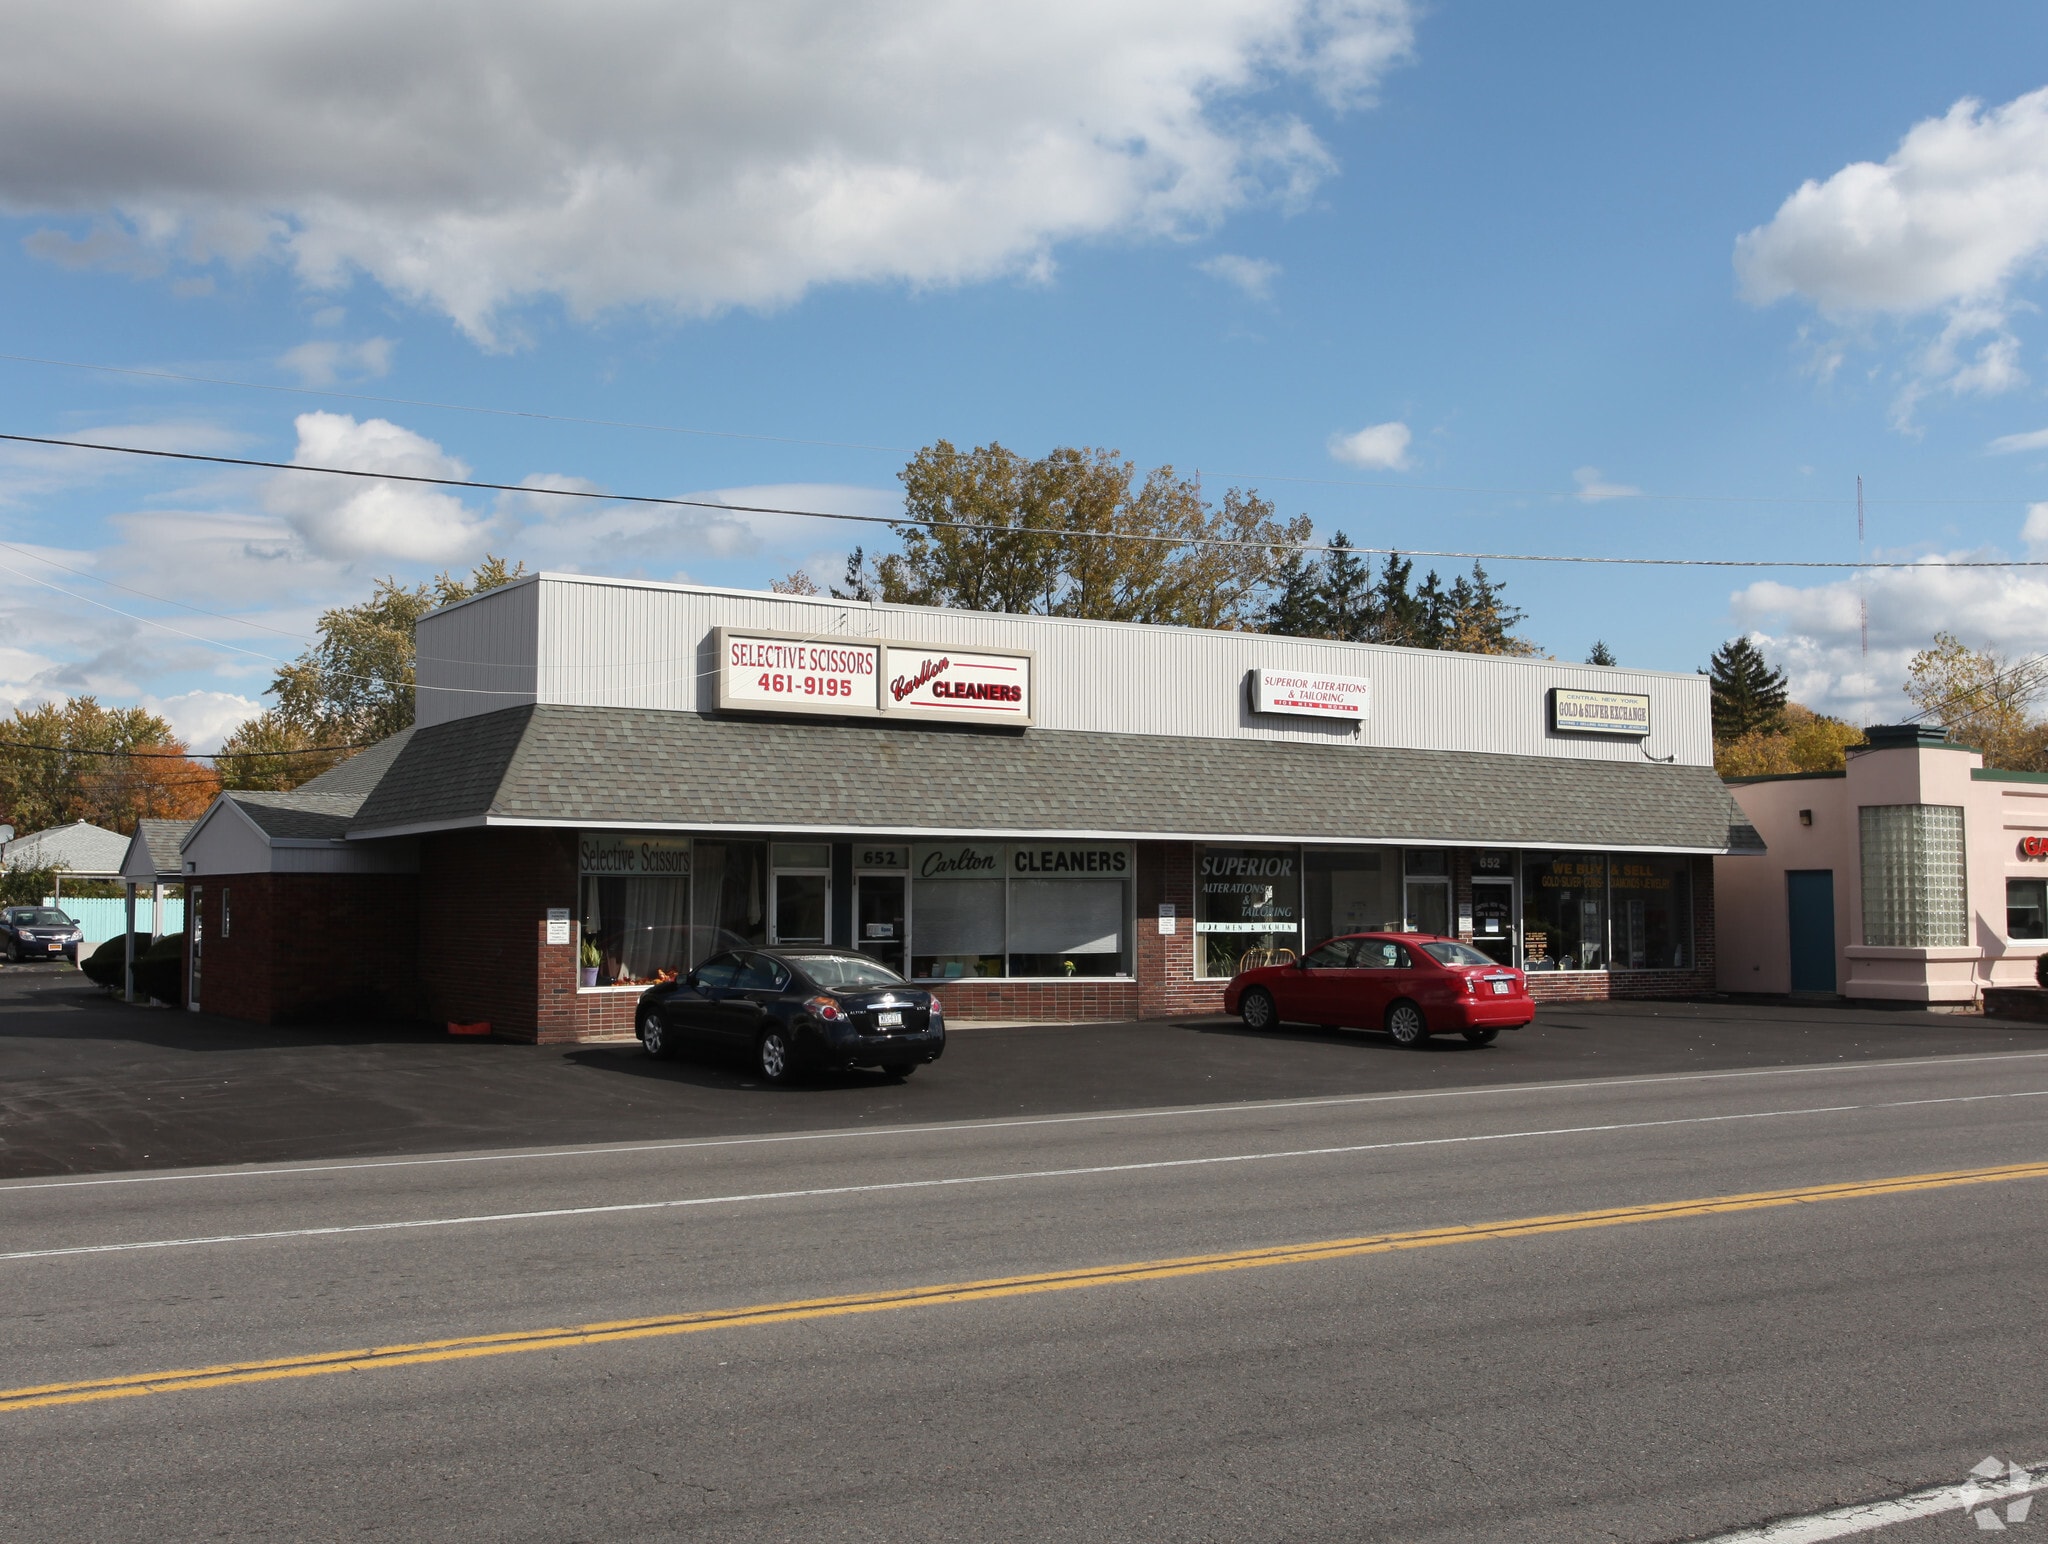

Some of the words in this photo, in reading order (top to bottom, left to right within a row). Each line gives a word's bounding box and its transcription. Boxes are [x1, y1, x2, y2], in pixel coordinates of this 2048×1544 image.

[731, 642, 806, 670] SELECTIVE
[810, 647, 873, 675] SCISSORS
[758, 673, 852, 697] 461-9195
[890, 655, 950, 702] Carlton
[1264, 676, 1308, 689] SUPERIOR
[1311, 680, 1367, 694] ALTERATIONS
[932, 680, 1022, 702] CLEANERS
[1287, 690, 1296, 699] &
[1299, 690, 1344, 702] TAILORING
[1566, 694, 1599, 702] CENTRAL
[1559, 701, 1578, 717] GOLD
[1579, 703, 1584, 718] &
[1584, 703, 1609, 720] SILVER
[1609, 705, 1647, 722] EXCHANGE
[581, 840, 635, 871] Selective
[641, 842, 689, 872] Scissors
[863, 851, 898, 865] 652
[921, 848, 996, 878] Carlton
[1014, 851, 1126, 872] CLEANERS
[1479, 857, 1501, 869] 652
[1200, 856, 1293, 877] SUPERIOR
[1552, 863, 1573, 875] WE
[1576, 863, 1603, 876] BUY
[1610, 864, 1619, 876] &
[1624, 864, 1654, 877] SELL
[1201, 882, 1266, 894] ALTERATIONS
[1242, 895, 1250, 905] &
[1240, 906, 1293, 917] TAILORING
[1202, 923, 1218, 931] FOR
[1225, 923, 1243, 931] MEN
